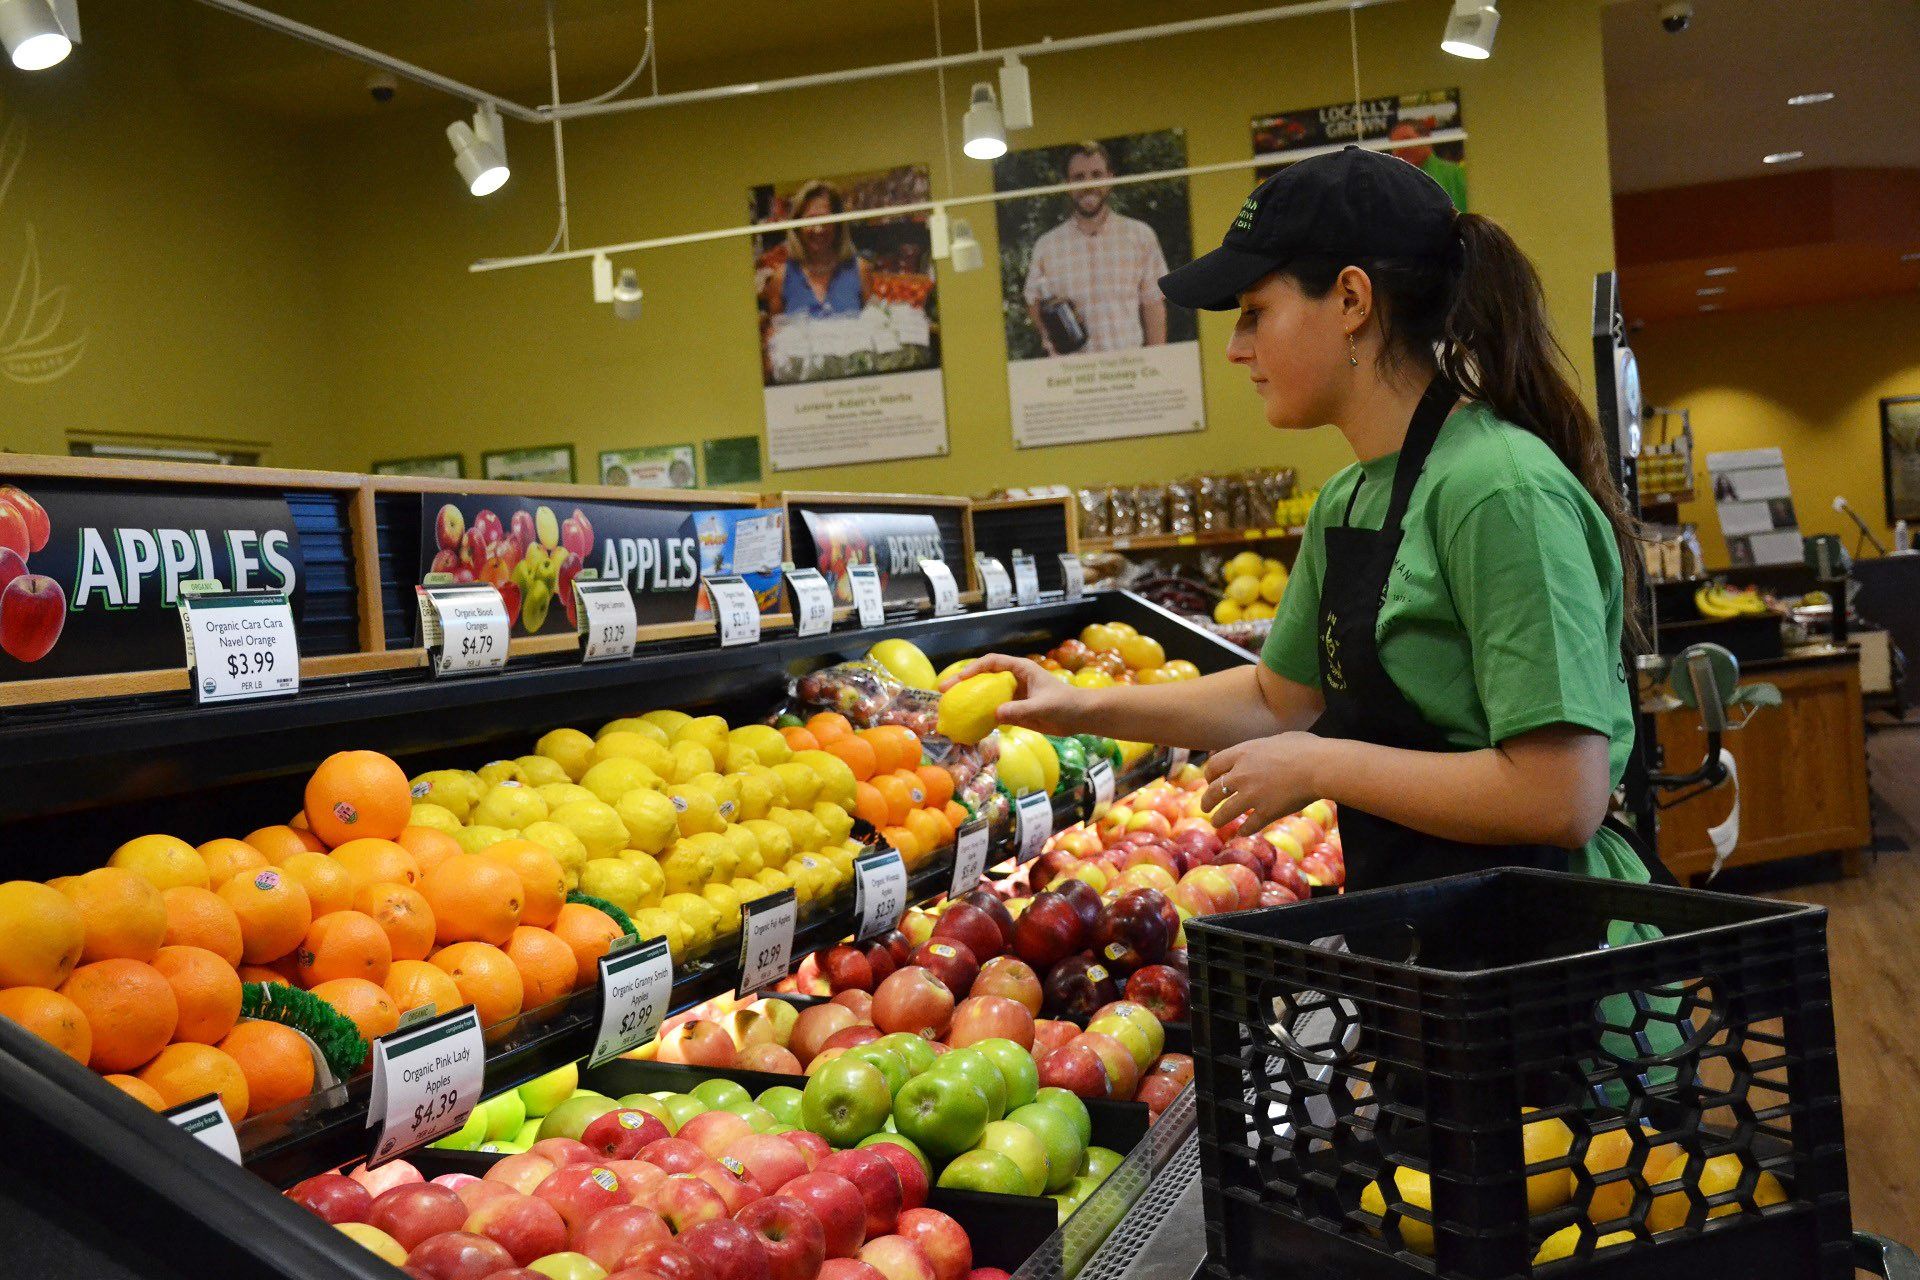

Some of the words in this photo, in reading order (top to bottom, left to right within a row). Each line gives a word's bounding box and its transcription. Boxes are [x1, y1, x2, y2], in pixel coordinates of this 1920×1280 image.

[1319, 100, 1396, 124] LOCALLY
[1325, 116, 1387, 138] GROWN
[71, 527, 296, 611] APPLES
[602, 537, 697, 591] APPLES
[454, 608, 476, 620] Organic
[206, 621, 240, 635] Organic
[241, 619, 262, 630] Cara
[263, 618, 283, 629] Cara
[219, 636, 244, 648] Navel
[245, 635, 276, 647] Orange
[461, 635, 493, 657] $4.79
[227, 651, 275, 679] $3.99
[241, 682, 253, 690] PER
[254, 681, 263, 689] LB
[757, 944, 782, 971] $2.99
[612, 982, 634, 998] Organic
[634, 973, 653, 989] Granny
[654, 968, 669, 982] Smith
[631, 991, 649, 1007] Apples
[619, 1004, 653, 1036] $2.99
[403, 1062, 434, 1083] Organic
[435, 1054, 453, 1070] Pink
[453, 1048, 471, 1063] Lady
[425, 1074, 451, 1096] Apples
[411, 1089, 458, 1132] $4.39
